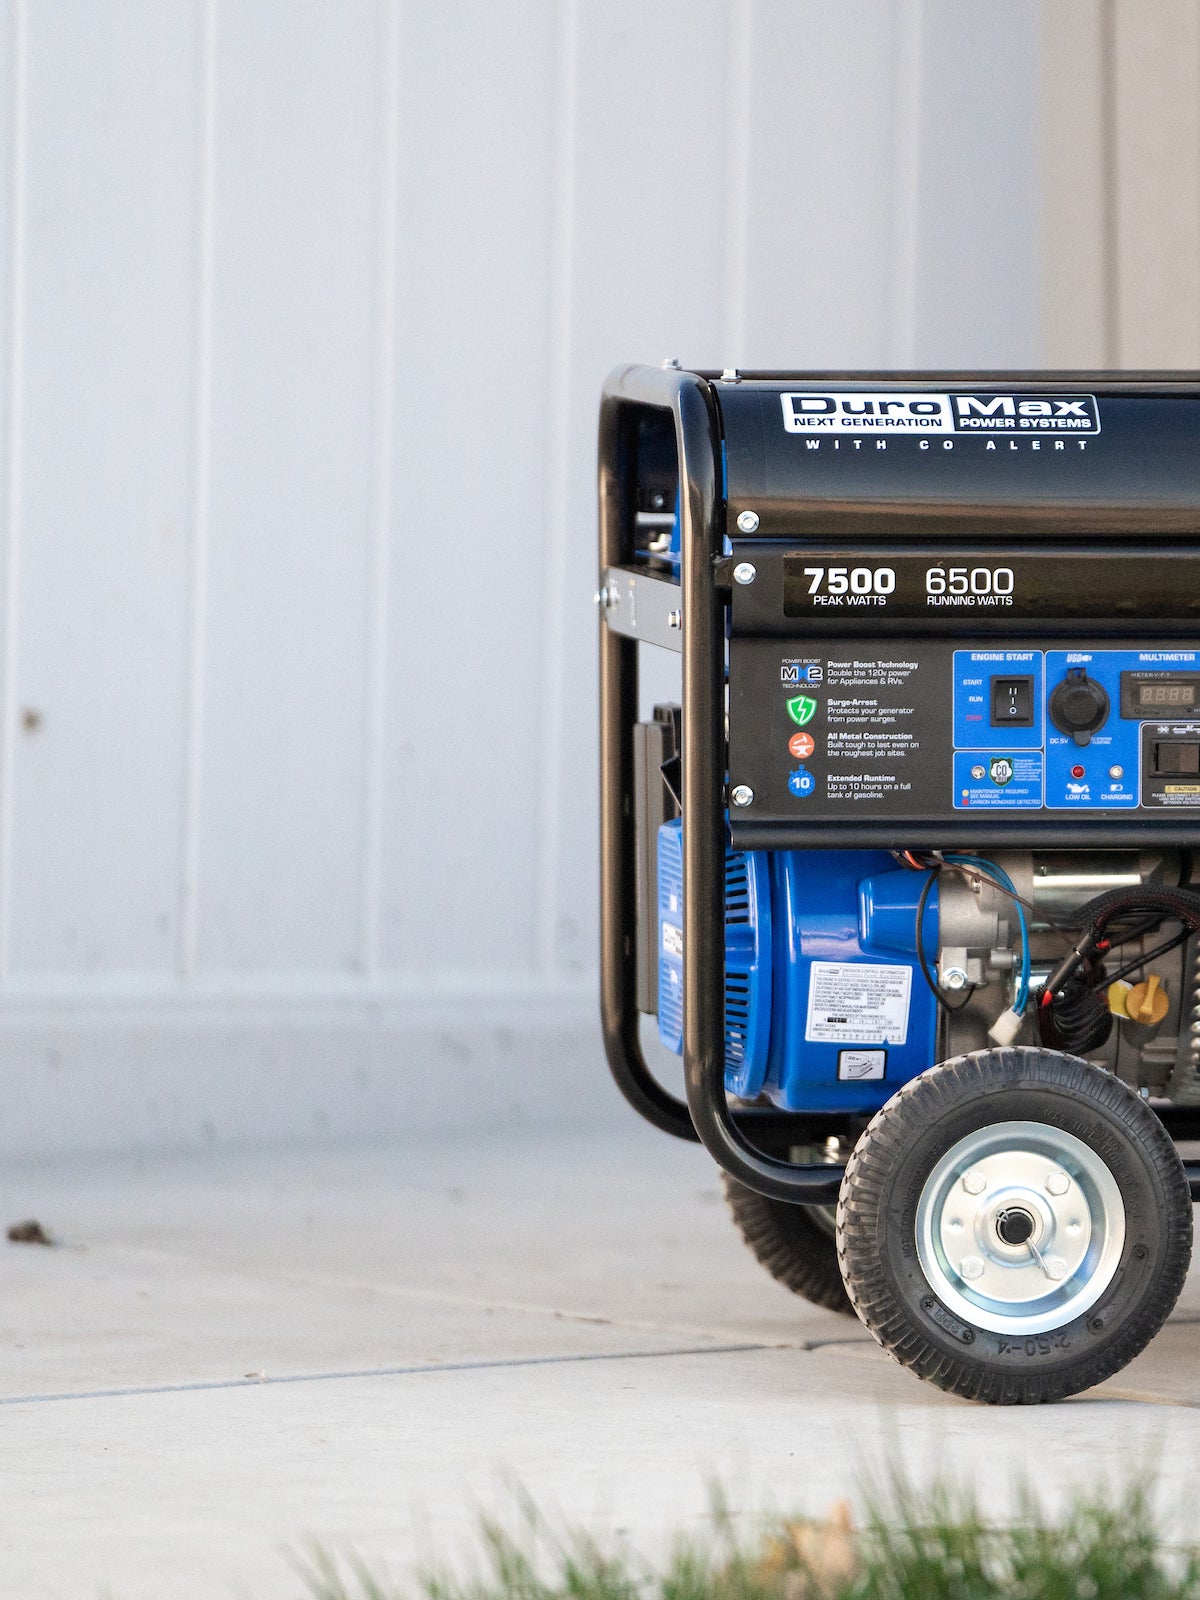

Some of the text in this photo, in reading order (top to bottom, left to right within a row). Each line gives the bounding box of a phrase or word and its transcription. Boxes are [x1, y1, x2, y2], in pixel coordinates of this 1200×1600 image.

[794, 418, 1091, 428] NEXT GENERATION POWER SYSTEMS
[806, 440, 1088, 450] WITH CO ALERT
[804, 568, 896, 594] 7500
[926, 568, 1014, 594] 6500
[814, 596, 886, 606] PEAK WATTS
[927, 596, 1013, 606] RUNNING WATTS
[877, 661, 918, 670] Technology
[888, 670, 911, 678] power
[840, 678, 878, 686] Appliances
[861, 708, 877, 716] your
[878, 708, 914, 716] generator
[846, 716, 868, 724] power
[870, 716, 896, 724] surges.
[996, 764, 1007, 776] CO
[792, 778, 810, 788] 10
[854, 792, 884, 800] gasoline.
